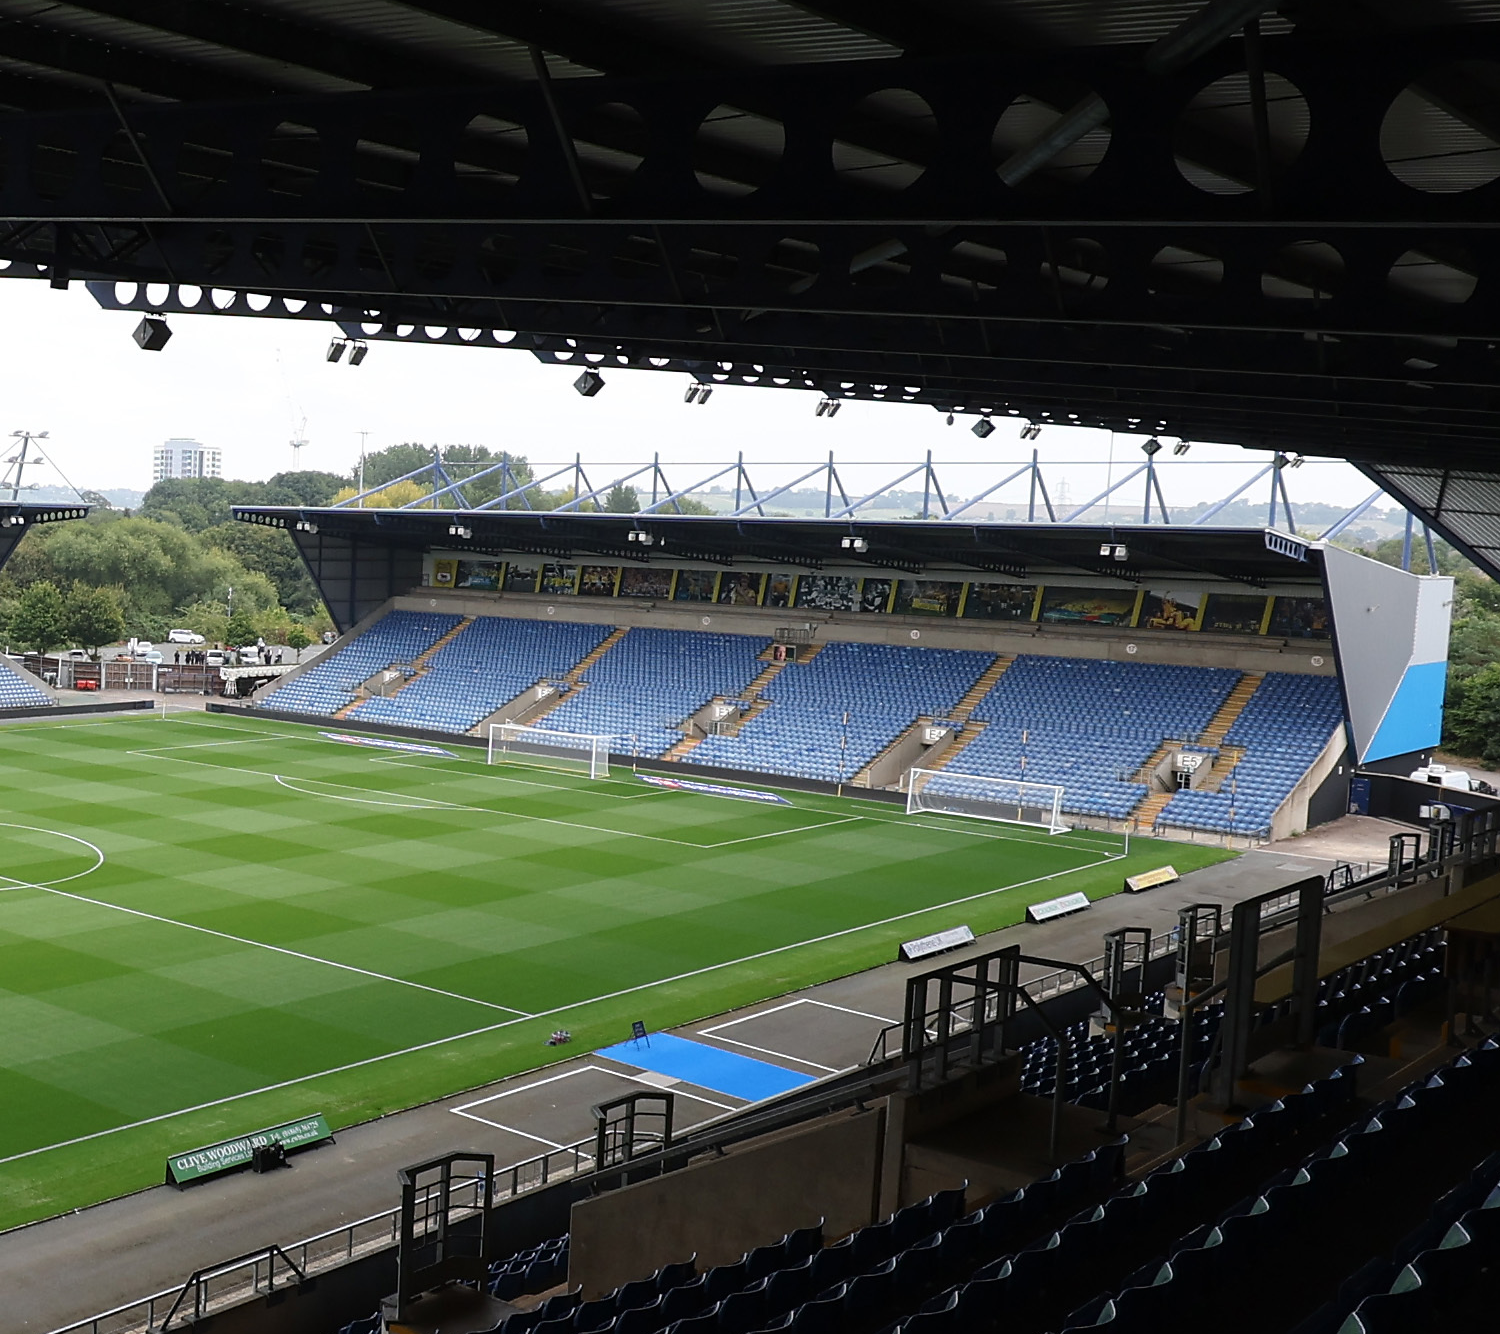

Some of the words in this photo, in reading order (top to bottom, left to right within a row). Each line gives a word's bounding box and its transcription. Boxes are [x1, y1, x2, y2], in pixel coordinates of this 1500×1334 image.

[930, 729, 942, 739] E4
[1182, 756, 1197, 767] E5
[177, 1152, 207, 1170] CLIVE
[207, 1135, 268, 1161] WOODWARD
[197, 1159, 221, 1173] Building
[222, 1152, 245, 1166] Services
